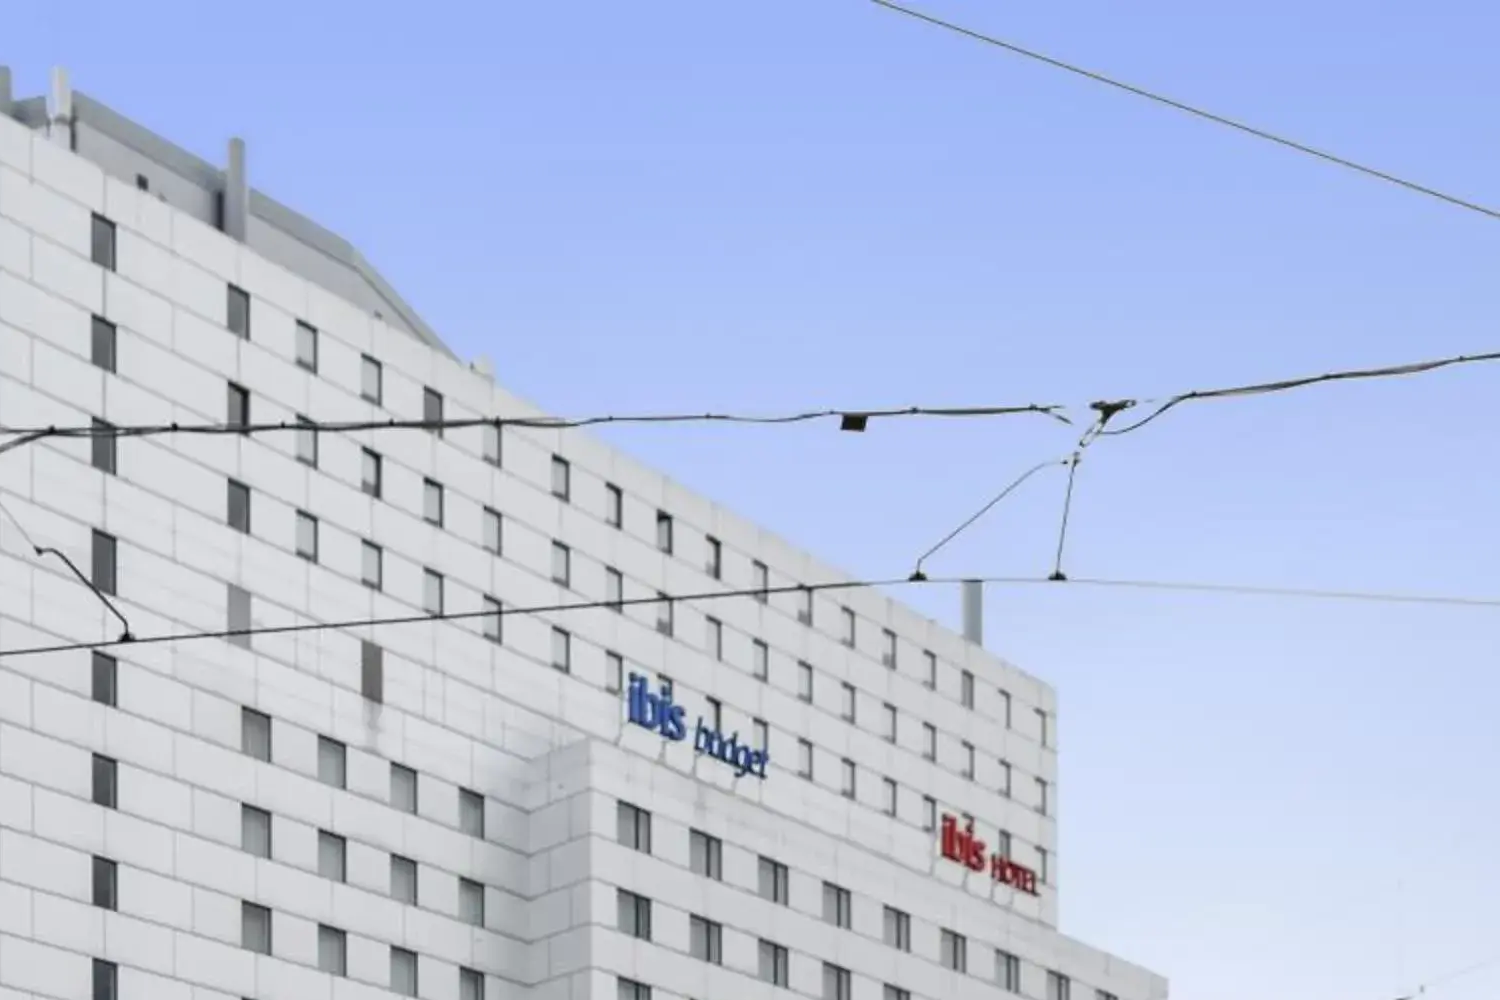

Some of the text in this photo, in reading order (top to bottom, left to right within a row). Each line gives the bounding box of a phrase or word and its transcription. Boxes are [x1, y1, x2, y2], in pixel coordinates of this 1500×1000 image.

[629, 672, 769, 780] ibis budget
[941, 812, 1040, 897] ibis HOTEL
